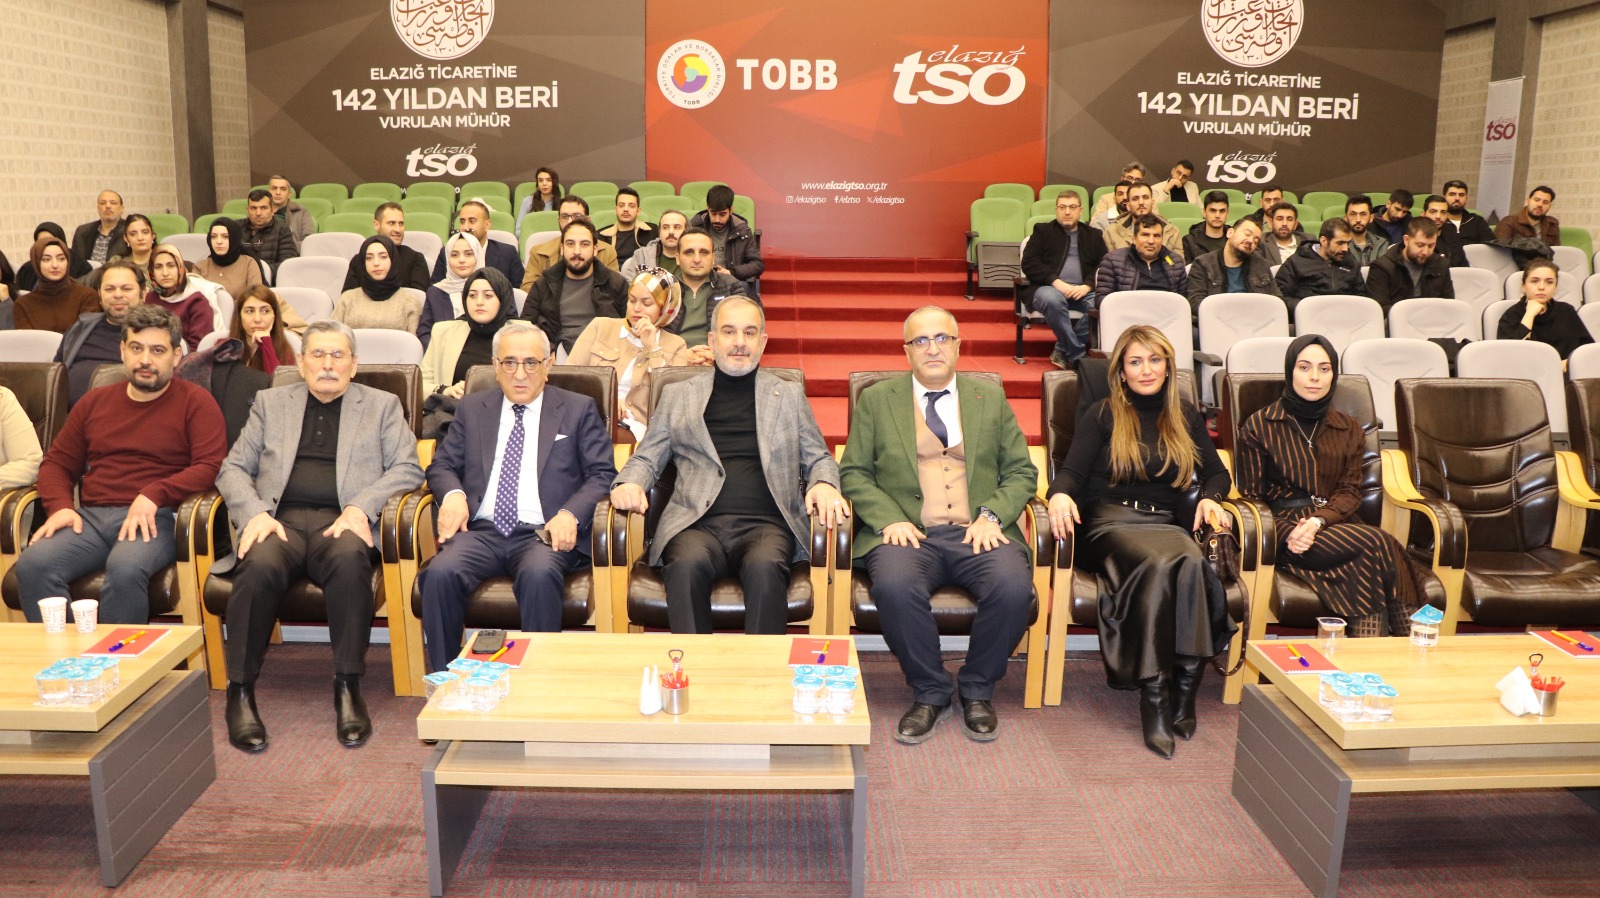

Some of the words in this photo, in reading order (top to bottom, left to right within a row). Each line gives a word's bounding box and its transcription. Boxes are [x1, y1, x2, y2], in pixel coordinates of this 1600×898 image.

[927, 44, 1027, 68] elazığ
[370, 64, 425, 80] ELAZIĞ
[428, 63, 518, 79] TİCARETİNE
[736, 58, 838, 91] TOBB
[893, 50, 1027, 106] tso
[1177, 70, 1231, 86] ELAZIĞ
[1235, 71, 1322, 89] TİCARETİNE
[332, 88, 377, 111] 142
[383, 86, 487, 110] YILDAN
[495, 80, 559, 108] BERİ
[1137, 91, 1182, 115] 142
[1189, 93, 1291, 118] YILDAN
[1298, 93, 1360, 120] BERİ
[379, 115, 452, 129] VURULAN
[455, 114, 511, 128] MÜHÜR
[1183, 121, 1255, 135] VURULAN
[1258, 122, 1312, 137] MÜHÜR
[1486, 120, 1516, 141] tso
[406, 147, 478, 177] tso
[1206, 153, 1277, 184] tso
[801, 180, 888, 192] www.elazigtso.org.tr
